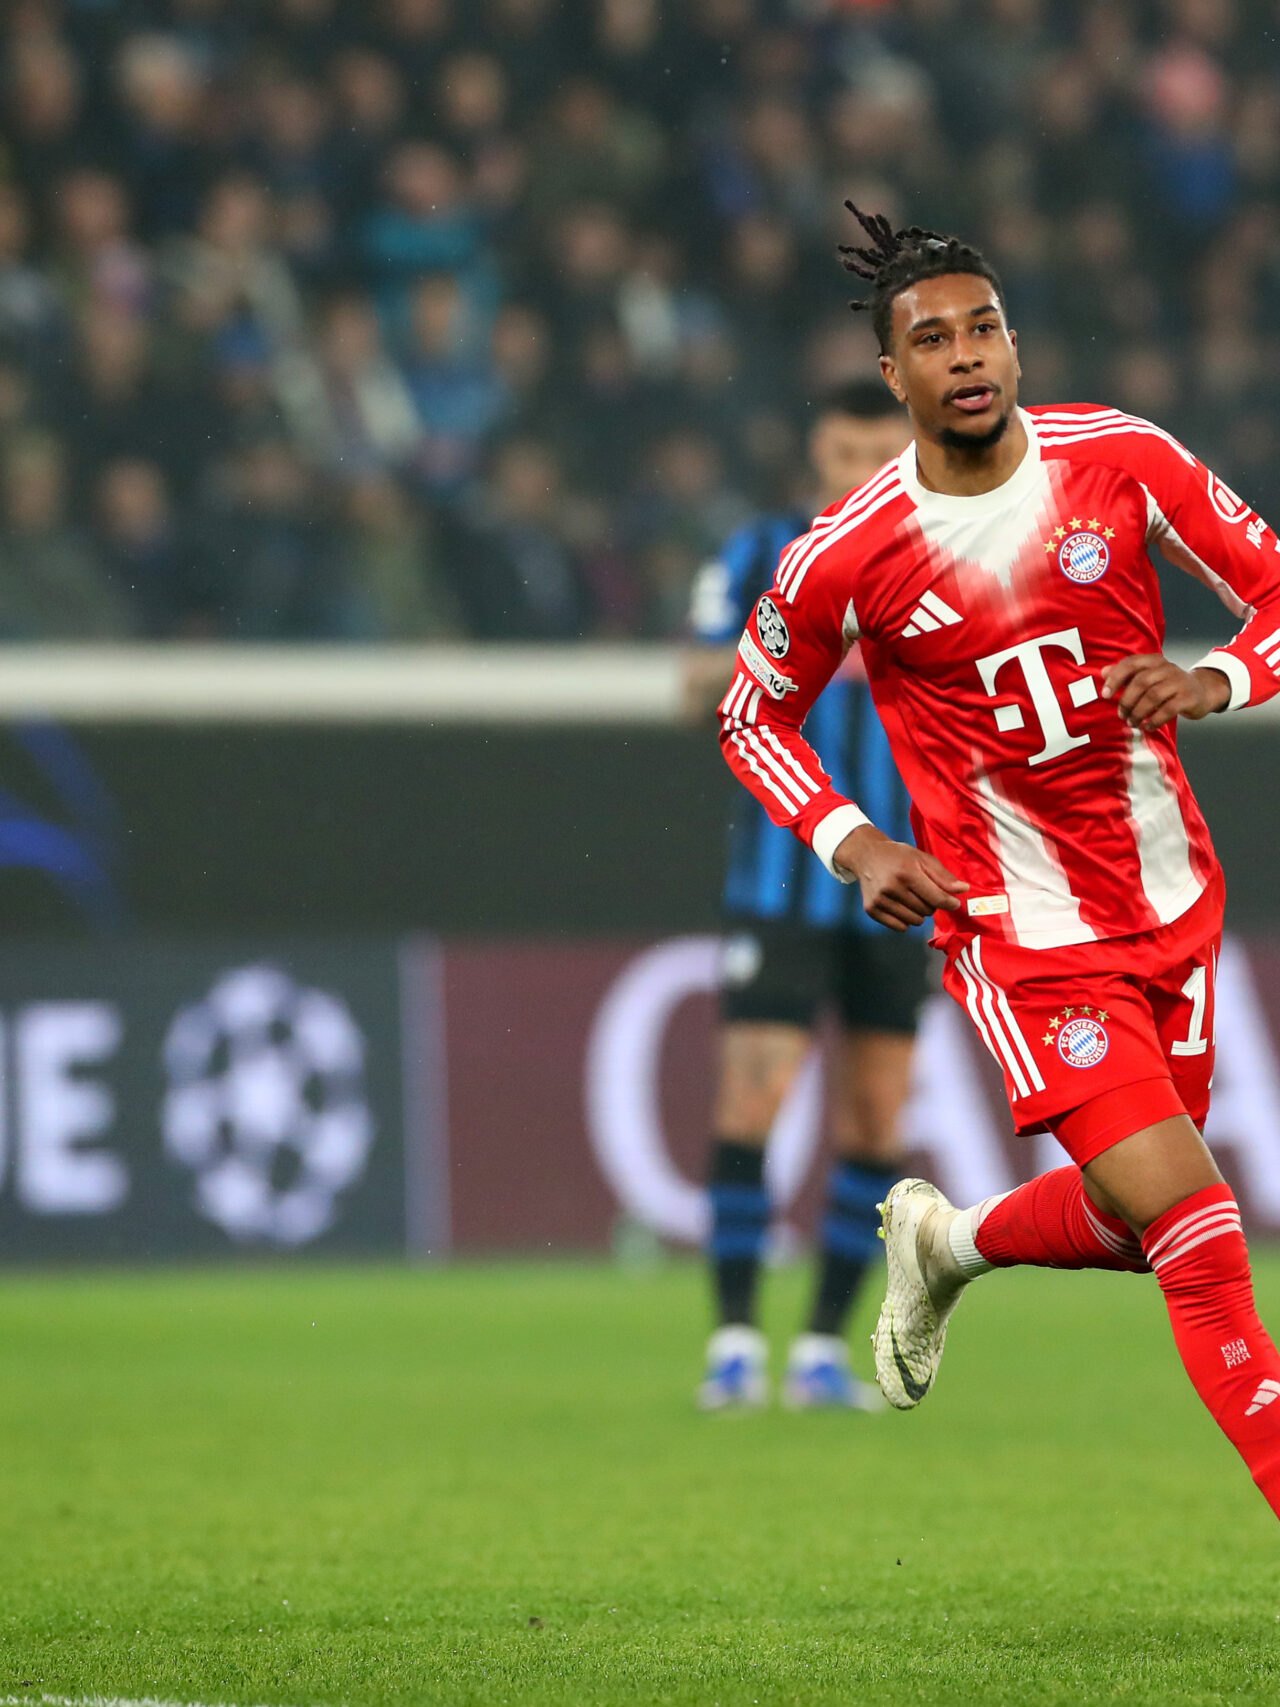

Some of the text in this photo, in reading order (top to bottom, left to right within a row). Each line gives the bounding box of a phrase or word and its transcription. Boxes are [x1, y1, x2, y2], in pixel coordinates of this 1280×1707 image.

[1062, 535, 1104, 559] FC BAYERN
[975, 627, 1098, 766] T
[1061, 1021, 1101, 1048] FC BAYERN
[0, 1000, 128, 1214] E
[1220, 1338, 1245, 1354] MIA
[1225, 1352, 1252, 1370] MIA
